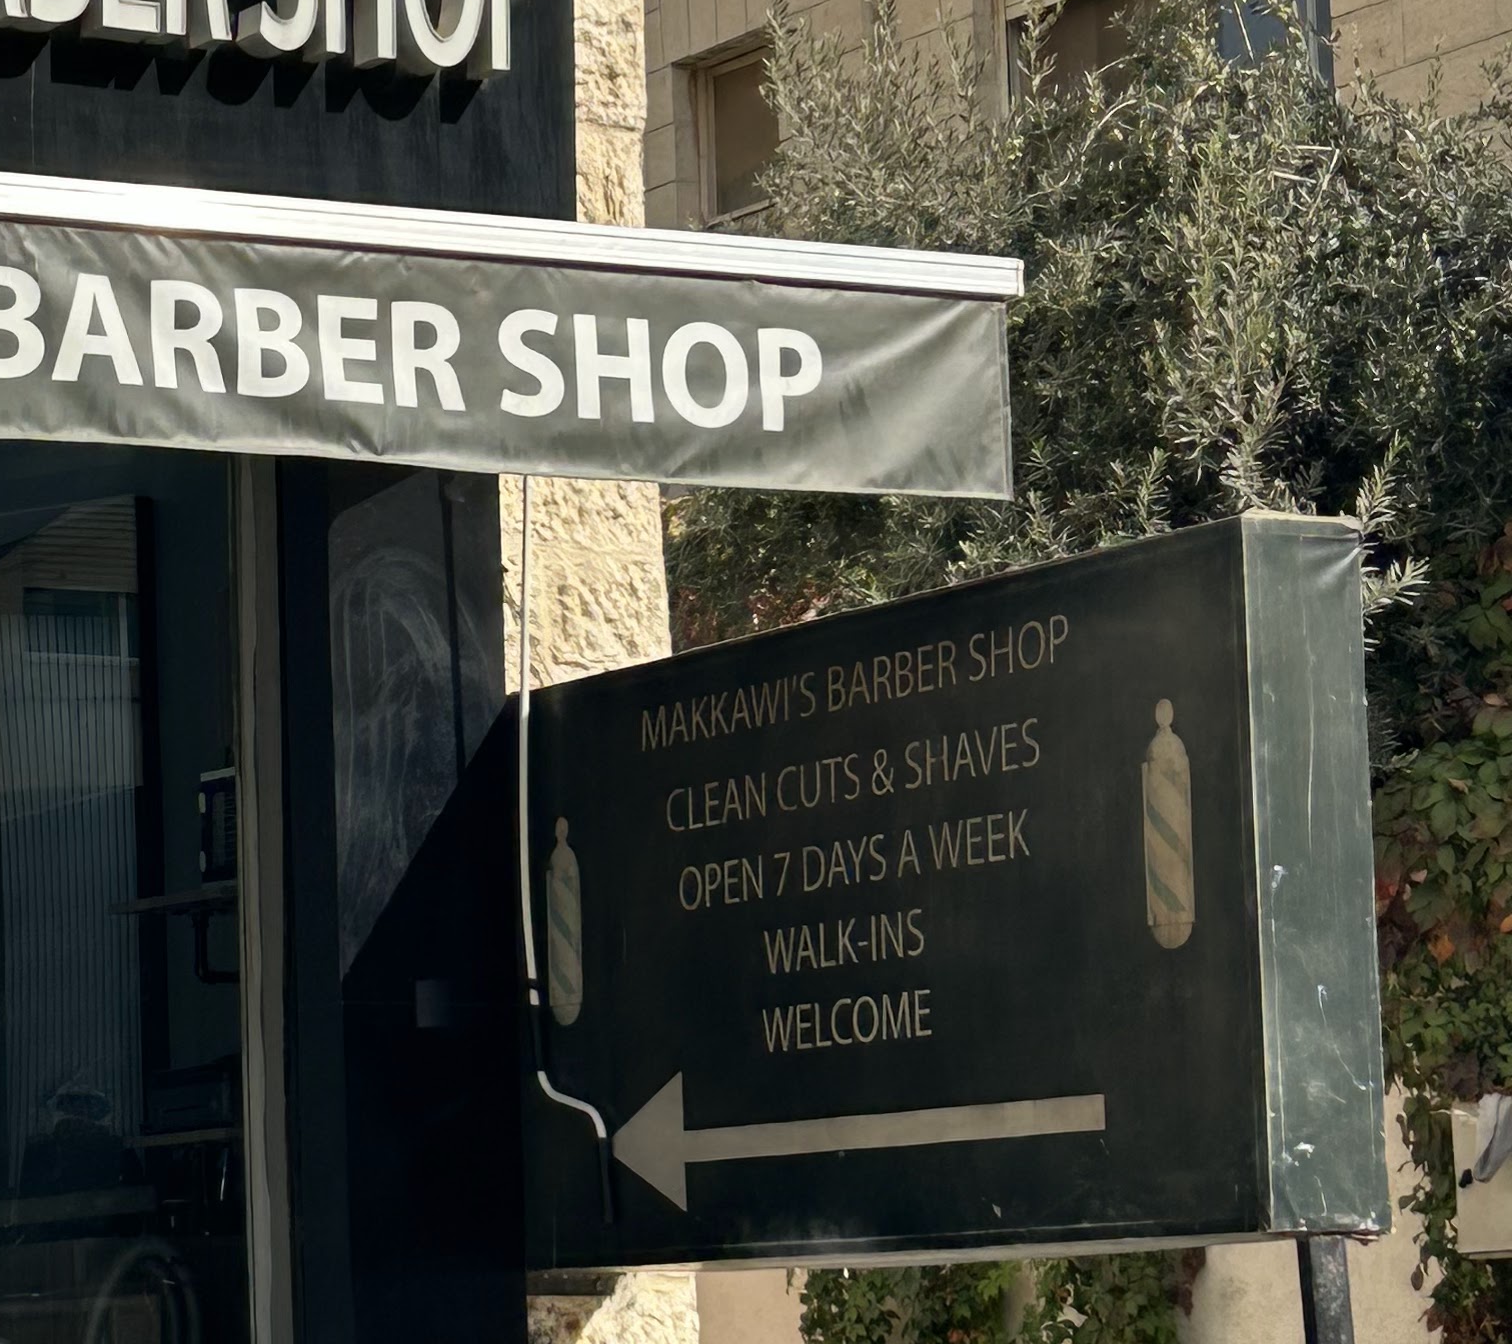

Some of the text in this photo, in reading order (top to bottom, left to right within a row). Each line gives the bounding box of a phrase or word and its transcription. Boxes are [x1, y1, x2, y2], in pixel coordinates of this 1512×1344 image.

[497, 307, 824, 433] SHOP
[641, 614, 1069, 752] MAKKAWI'S BARBER SHOP
[666, 717, 1040, 833] CLEAN CUTS & SHAVES
[679, 808, 1030, 911] OPEN 7 DAYS A WEEK
[763, 908, 925, 975] WALK-INS
[762, 989, 932, 1053] WELCOME
